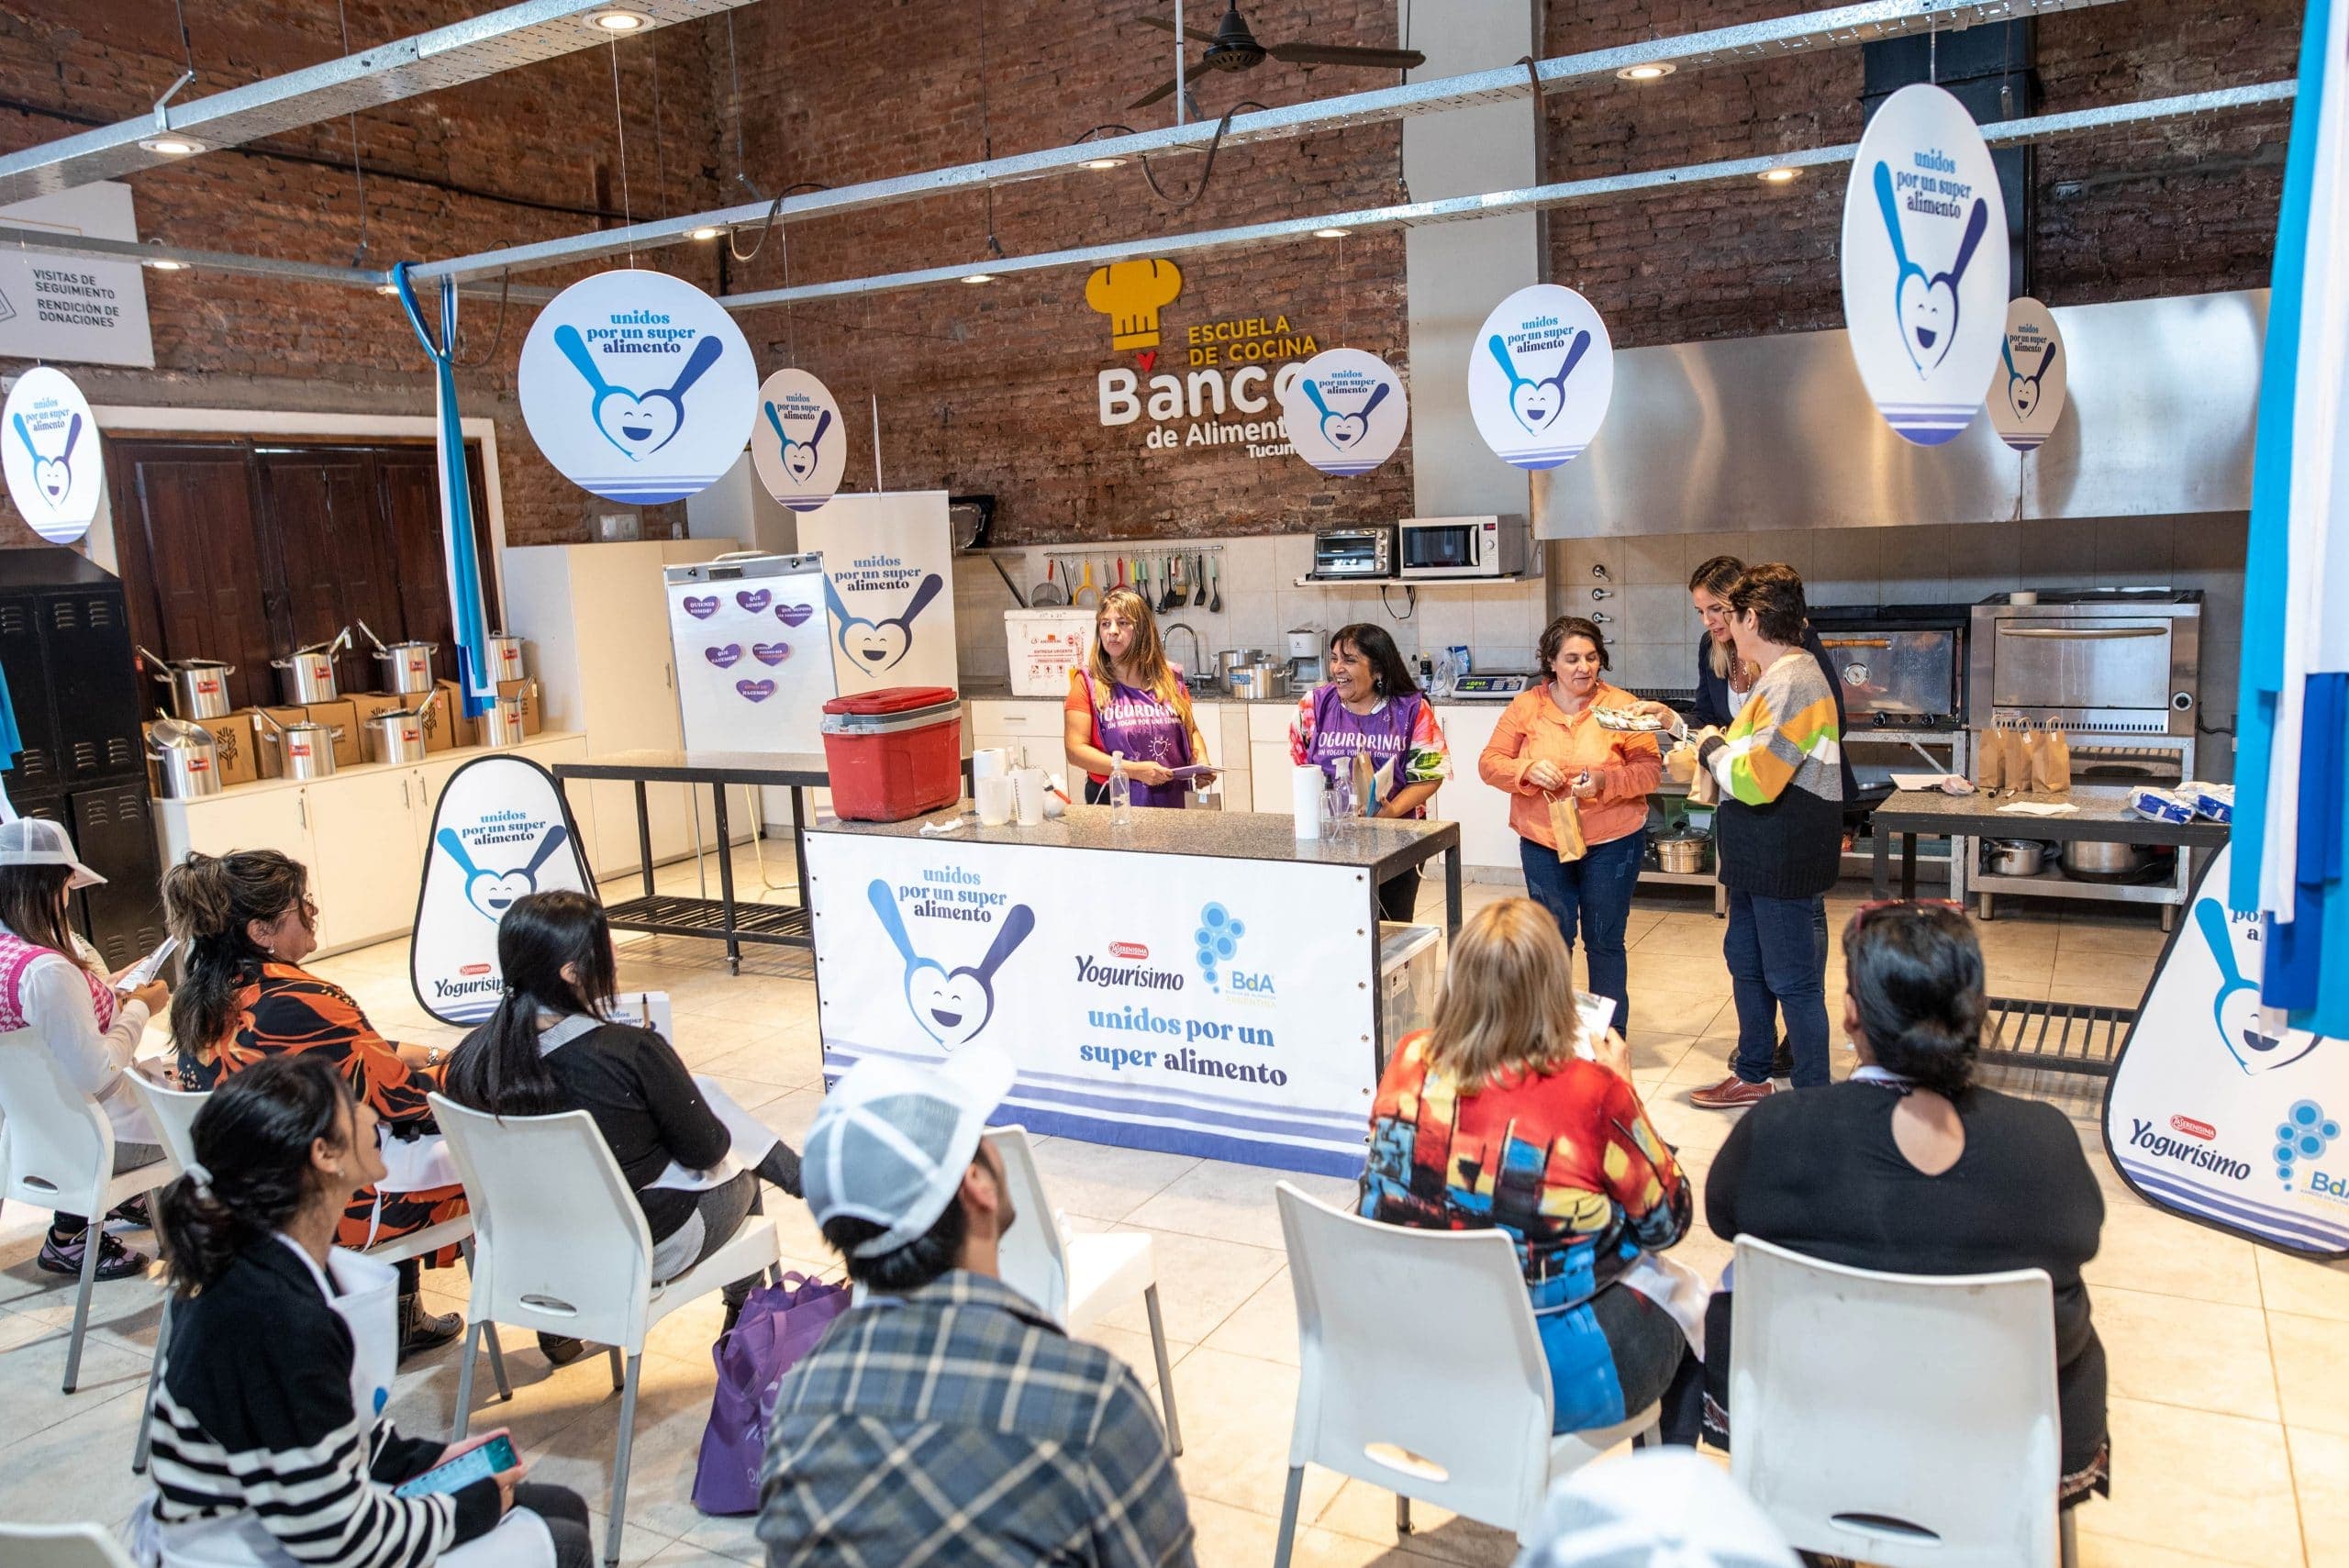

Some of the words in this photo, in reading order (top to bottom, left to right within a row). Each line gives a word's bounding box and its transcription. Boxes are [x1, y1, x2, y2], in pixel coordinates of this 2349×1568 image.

[1914, 149, 1955, 173] unidos
[1897, 172, 1918, 191] por
[1921, 176, 1936, 192] un
[1940, 180, 1971, 202] super
[1908, 191, 1961, 218] alimento
[33, 269, 78, 284] VISITAS
[81, 274, 95, 285] DE
[36, 282, 115, 299] SEGUIMIENTO
[38, 299, 101, 315] RENDICIÓN
[105, 306, 119, 317] DE
[39, 311, 115, 328] DONACIONES
[610, 310, 670, 324] unidos
[1521, 316, 1558, 330] unidos
[586, 328, 618, 342] por
[621, 328, 643, 339] un
[647, 328, 696, 342] super
[1188, 315, 1290, 344] ESCUELA
[1508, 334, 1526, 346] por
[1528, 331, 1542, 340] un
[1544, 326, 1574, 340] super
[2019, 323, 2038, 333] unidos
[603, 339, 681, 353] alimento
[1517, 339, 1564, 353] alimento
[2010, 335, 2021, 343] por
[2031, 337, 2047, 345] super
[2015, 342, 2041, 352] alimento
[1189, 347, 1219, 366] DE
[1229, 336, 1318, 361] COCINA
[33, 397, 58, 409] unidos
[785, 394, 809, 402] unidos
[26, 414, 38, 424] por
[50, 409, 70, 420] super
[777, 404, 789, 412] por
[801, 405, 820, 413] super
[784, 410, 815, 420] alimento
[34, 420, 64, 431] alimento
[1146, 425, 1179, 450] de
[1186, 416, 1288, 447] Aliment
[853, 555, 901, 568] unidos
[835, 571, 859, 583] por
[862, 571, 879, 579] un
[882, 568, 921, 580] super
[847, 580, 909, 592] alimento
[1318, 732, 1408, 751] OGURDRINAS
[480, 810, 527, 823] unidos
[462, 827, 485, 839] por
[508, 820, 546, 832] super
[473, 832, 534, 845] alimento
[923, 865, 981, 885] unidos
[899, 885, 930, 901] por
[932, 887, 954, 902] un
[958, 890, 1007, 907] super
[914, 900, 991, 922] alimento
[2232, 910, 2262, 923] po
[1075, 954, 1184, 991] Yogurísimo
[1231, 971, 1275, 994] BdA
[1088, 1006, 1182, 1035] unidos
[1186, 1019, 1233, 1042] por
[1238, 1026, 1275, 1047] un
[1080, 1044, 1157, 1071] super
[1164, 1047, 1287, 1086] alimento
[2130, 1118, 2251, 1180] Yogurísimo
[2311, 1171, 2349, 1198] Bd
